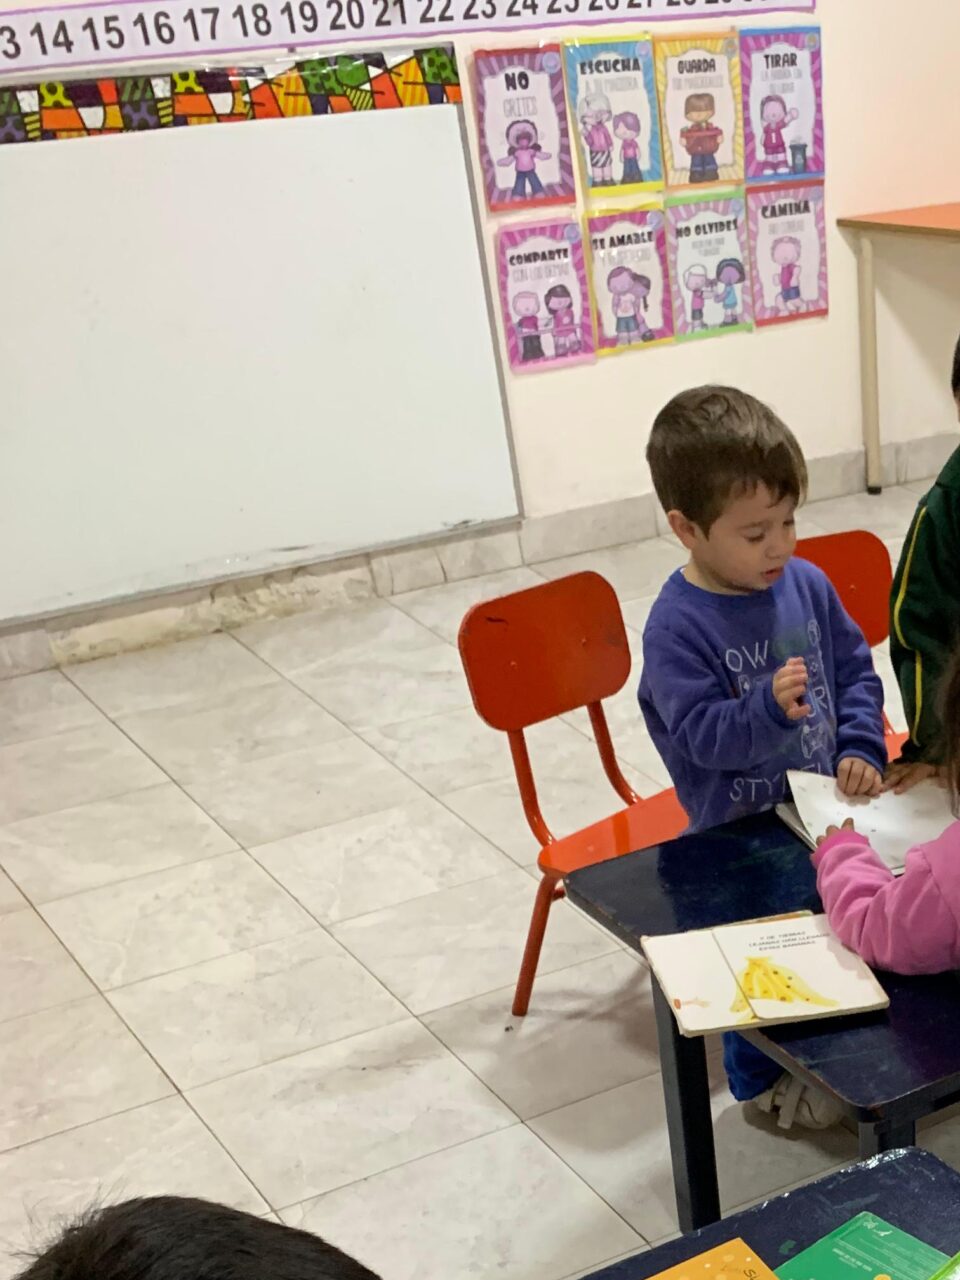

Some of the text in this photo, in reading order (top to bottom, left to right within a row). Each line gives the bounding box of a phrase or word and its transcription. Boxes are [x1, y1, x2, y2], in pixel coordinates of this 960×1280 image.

[30, 20, 74, 56] 14
[82, 15, 126, 51] 15
[133, 11, 176, 47] 16
[183, 7, 221, 43] 17
[232, 3, 273, 38] 18
[280, 0, 319, 34] 19
[327, 0, 366, 31] 20
[375, 0, 407, 27] 21
[419, 0, 455, 24] 22
[579, 58, 641, 75] ESCUCHA
[677, 58, 716, 74] GUARDA
[763, 53, 798, 69] TIRAR
[504, 71, 529, 91] NO
[675, 217, 738, 240] NO OLVIDES
[608, 230, 654, 249] AMABLE
[508, 248, 569, 267] COMPARTE
